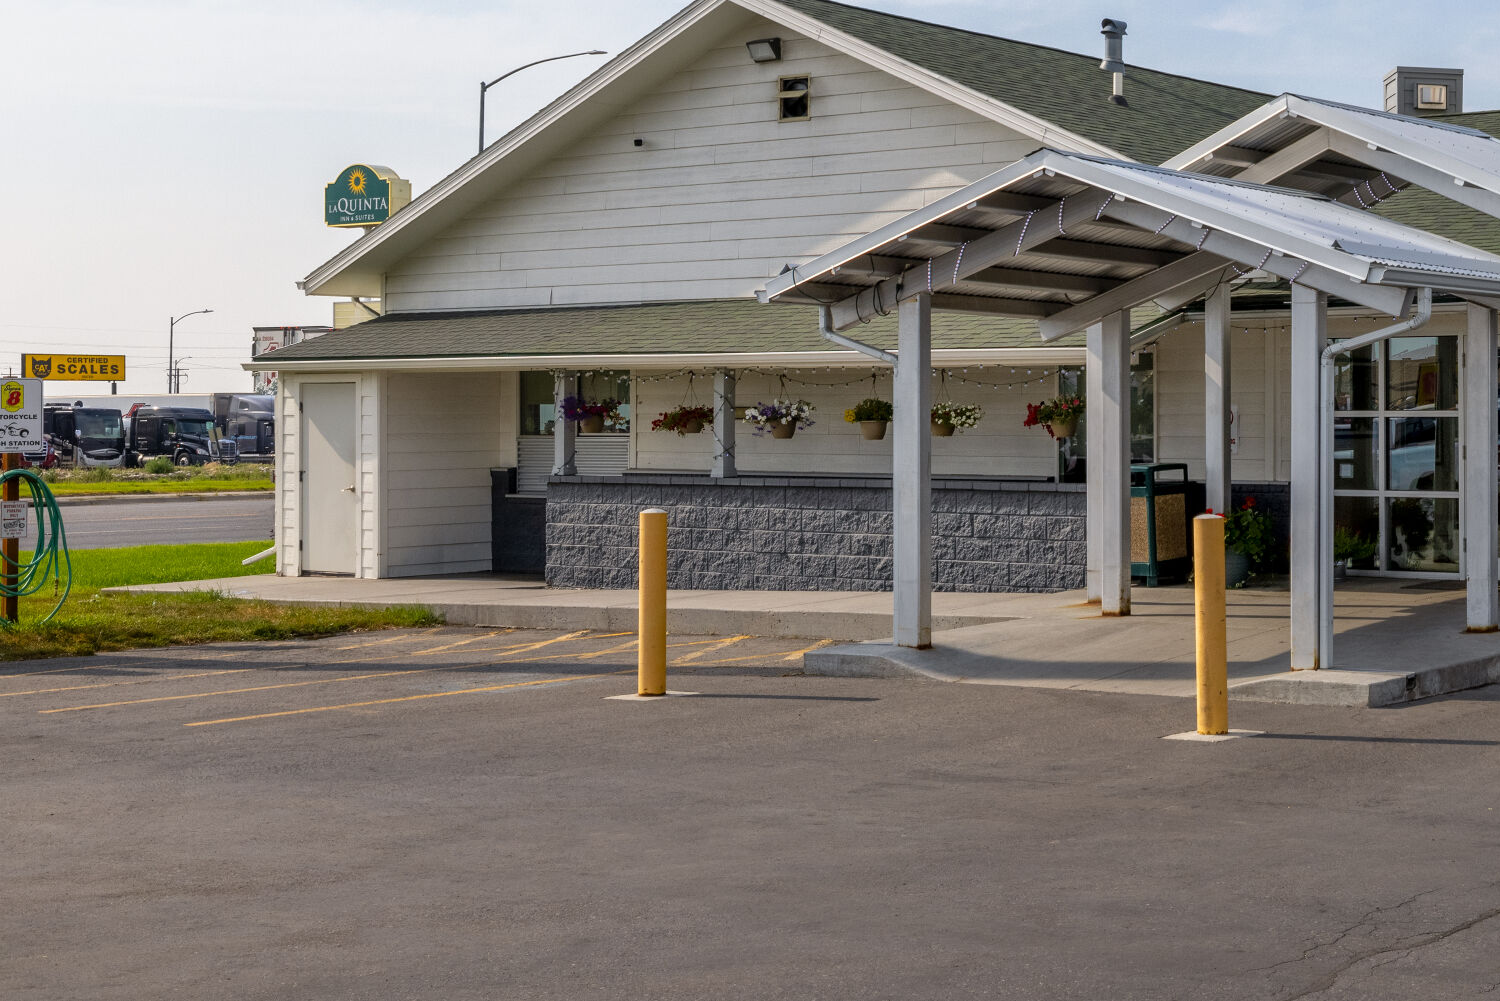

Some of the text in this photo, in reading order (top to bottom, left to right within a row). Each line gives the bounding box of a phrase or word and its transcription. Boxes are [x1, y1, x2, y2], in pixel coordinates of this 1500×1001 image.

[34, 364, 48, 372] CAT
[57, 364, 119, 374] SCALES
[6, 391, 21, 406] 8
